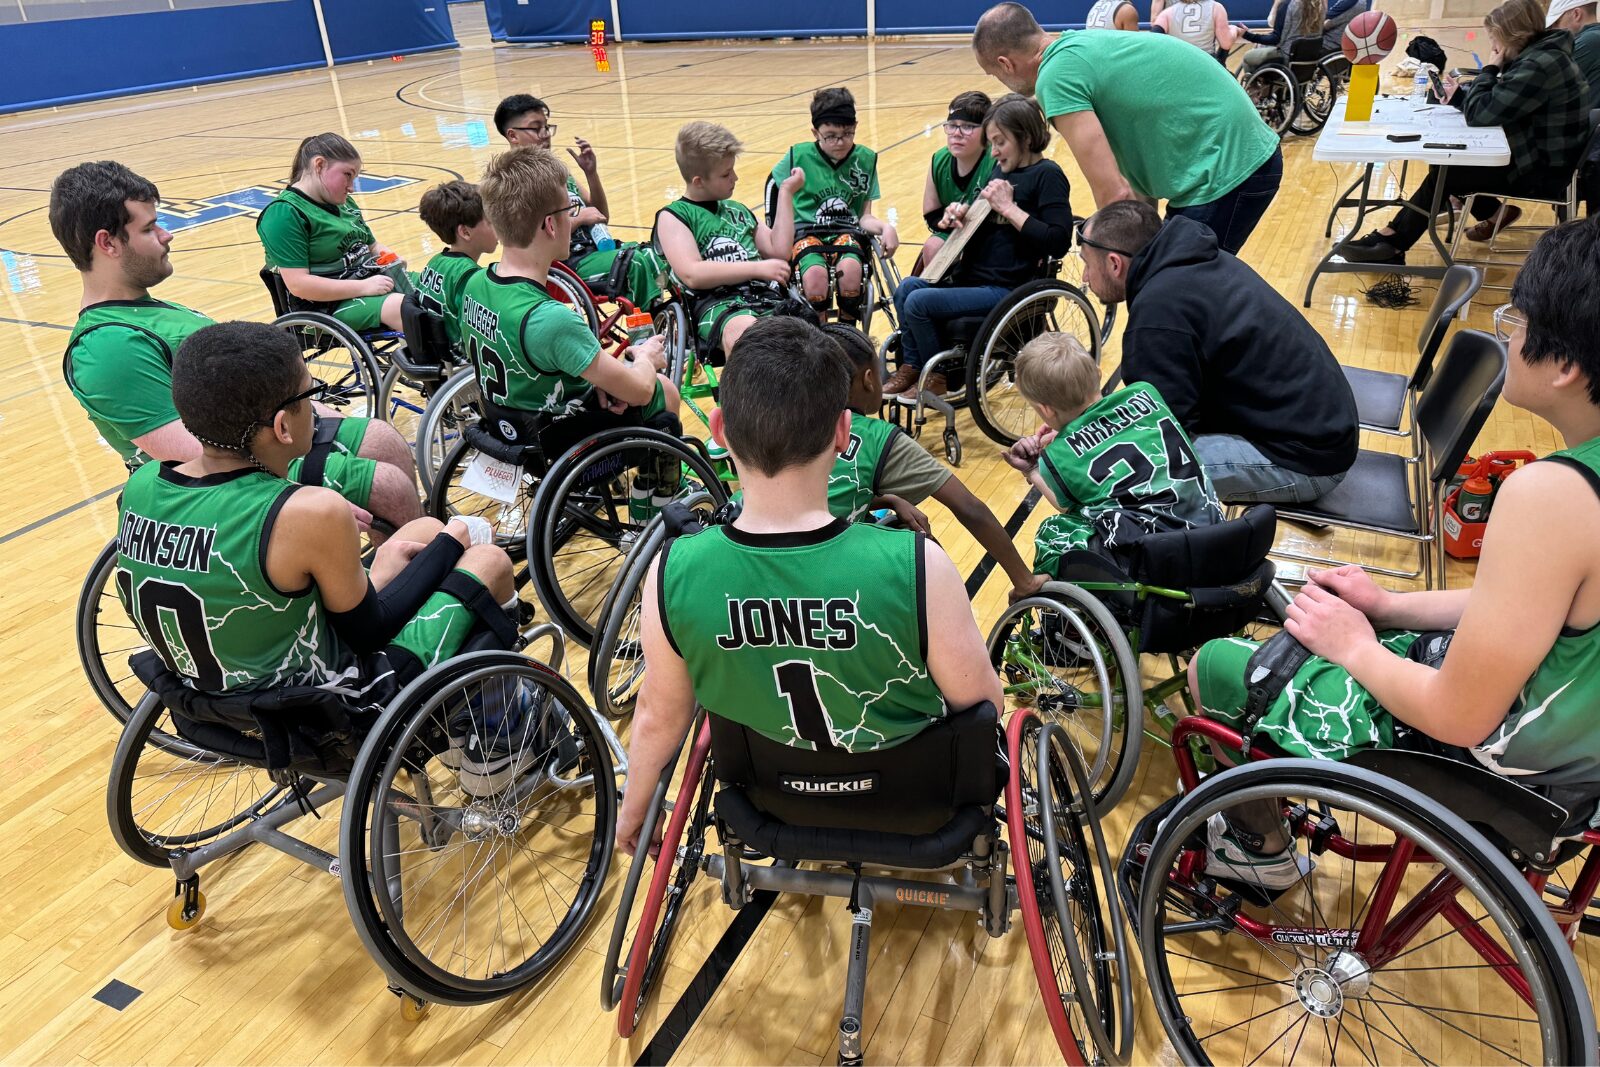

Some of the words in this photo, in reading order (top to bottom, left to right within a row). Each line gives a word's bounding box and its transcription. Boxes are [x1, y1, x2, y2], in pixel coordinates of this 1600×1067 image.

[1182, 2, 1201, 34] 2
[591, 31, 604, 45] 30
[813, 186, 838, 204] MUSIC
[848, 168, 870, 192] 53
[724, 205, 750, 230] 14
[462, 294, 499, 344] PLUEGER
[468, 334, 508, 404] 12
[1065, 390, 1159, 459] MIHAJLOV
[484, 466, 514, 480] PLUEGER
[1087, 416, 1207, 506] 24
[117, 510, 217, 574] JOHNSON
[115, 567, 228, 691] 10
[715, 598, 858, 651] JONES
[773, 660, 852, 752] 1
[790, 778, 873, 792] QUICKIE
[896, 888, 947, 905] QUICKIE
[1276, 934, 1305, 944] QUICKIE
